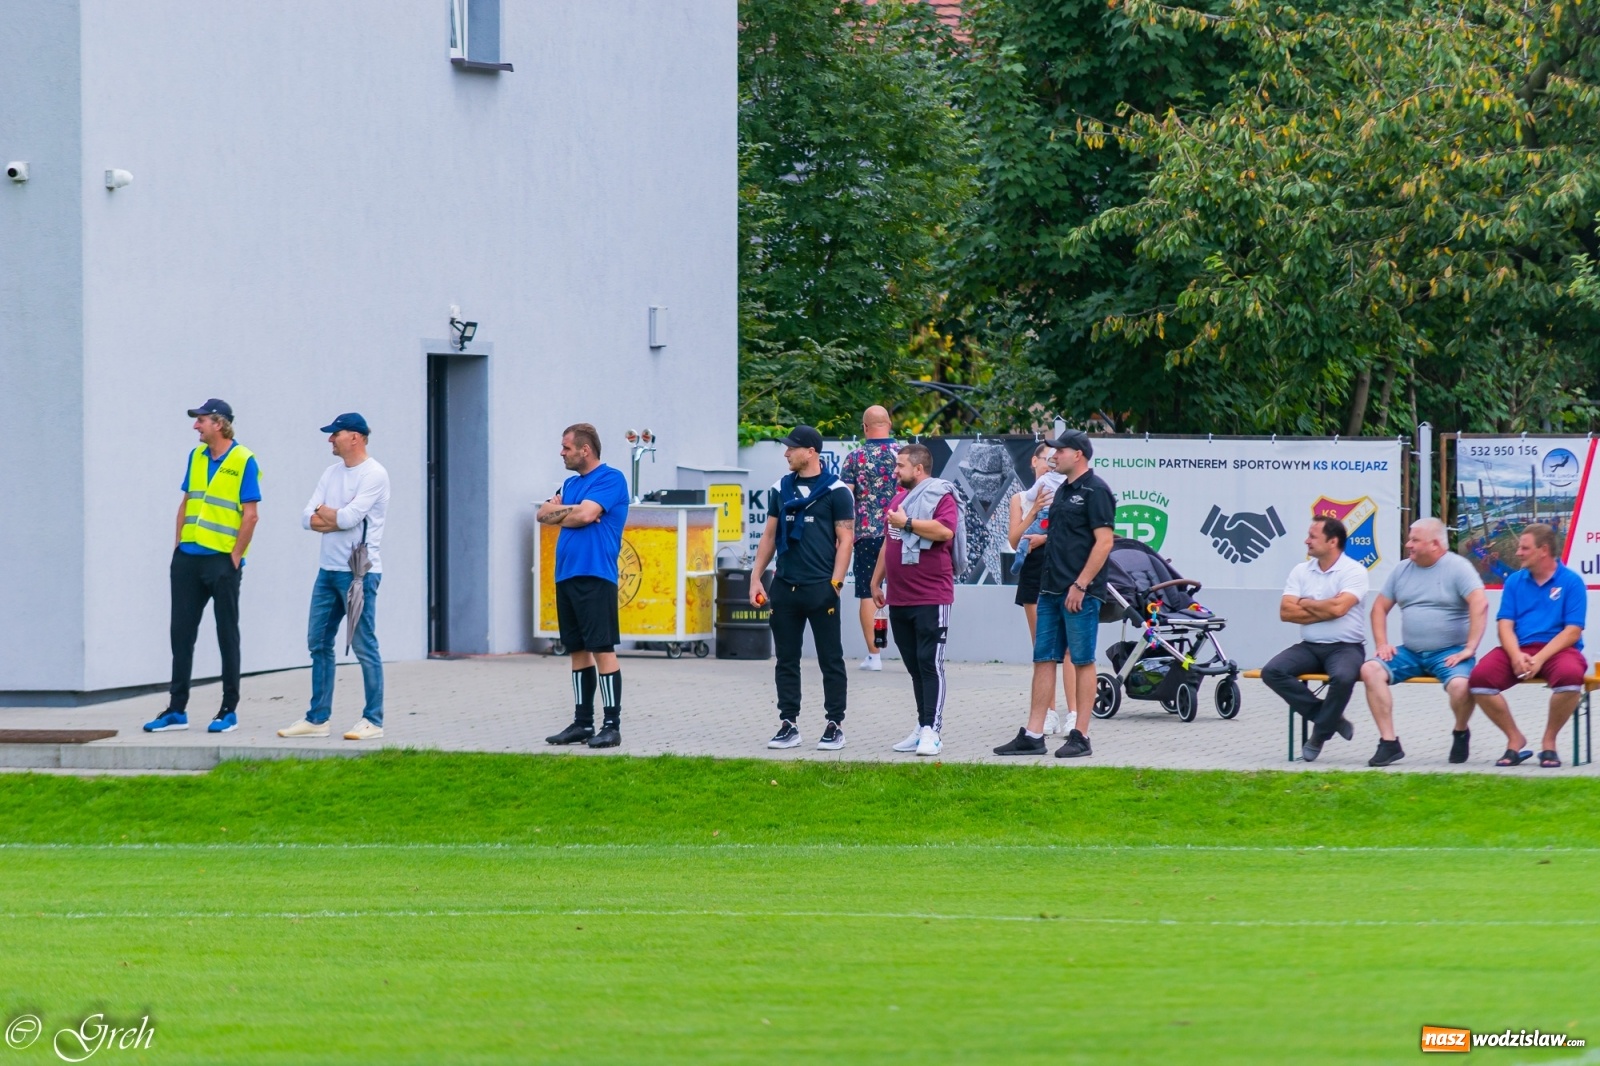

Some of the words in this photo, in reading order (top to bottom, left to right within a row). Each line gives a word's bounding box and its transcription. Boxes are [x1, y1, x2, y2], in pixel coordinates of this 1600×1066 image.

[1470, 446, 1490, 456] 532
[1494, 446, 1514, 456] 950
[1518, 446, 1538, 456] 156
[1094, 458, 1109, 468] FC
[1112, 458, 1156, 468] HLUCIN
[1158, 458, 1227, 469] PARTNEREM
[1233, 459, 1310, 470] SPORTOWYM
[1313, 460, 1328, 471] KS
[1331, 460, 1388, 473] KOLEJARZ
[1321, 509, 1337, 519] KS
[1349, 536, 1371, 546] 1933
